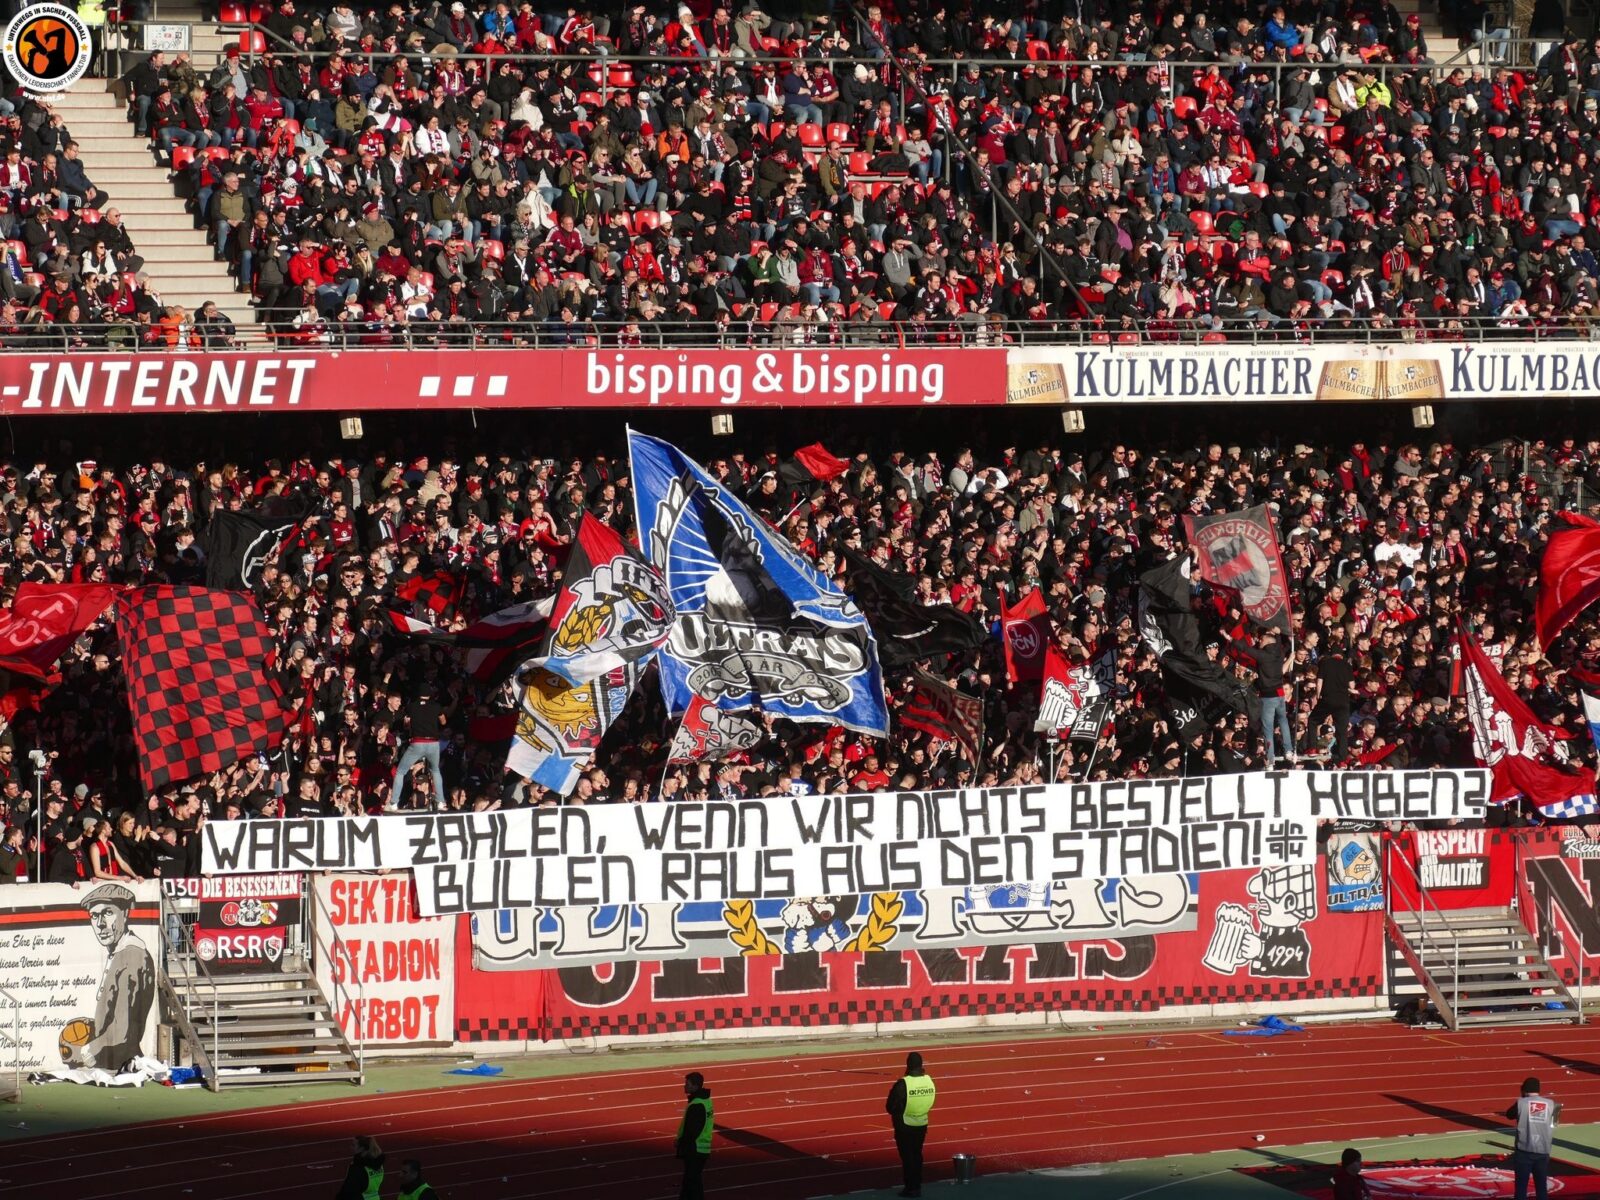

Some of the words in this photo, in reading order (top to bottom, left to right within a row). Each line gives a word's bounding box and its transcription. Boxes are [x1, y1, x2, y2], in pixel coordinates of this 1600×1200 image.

[586, 353, 742, 404] bisping
[751, 353, 784, 393] &
[793, 353, 944, 404] bisping
[1074, 351, 1313, 397] KULMBACHER
[1007, 379, 1063, 402] KULMBACHER
[1323, 375, 1377, 398] KULMBACHER
[1385, 375, 1440, 398] KULMBACHER
[668, 613, 867, 671] ULTRAS
[759, 658, 784, 673] ÅR
[205, 817, 383, 870] WARUM
[405, 807, 607, 865] ZAHLEN,
[634, 801, 769, 851] WENN
[792, 795, 876, 844] WIR
[896, 785, 1047, 842] NICHTS
[1070, 771, 1292, 832] BESTELLT
[1306, 769, 1488, 818] HABEN?
[1416, 829, 1487, 856] RESPEKT
[432, 852, 636, 914] BULLEN
[661, 848, 795, 901] RAUS
[820, 840, 923, 895] AUS
[939, 834, 1034, 887] DEN
[1052, 819, 1262, 881] STADIEN!
[1420, 858, 1484, 888] RIVALITÄT
[163, 878, 200, 897] 030
[201, 877, 223, 898] DIE
[224, 873, 299, 898] BESESSENEN
[1327, 883, 1383, 905] ULTRAS
[330, 878, 443, 927] SEKTI
[12, 934, 30, 948] Ehre
[32, 935, 45, 950] für
[46, 934, 65, 945] diese
[217, 935, 263, 959] RSR
[20, 956, 44, 968] Verein
[45, 955, 61, 966] und
[330, 938, 440, 984] STADION
[1267, 945, 1304, 967] 1994
[20, 976, 58, 990] Nürnbergs
[60, 979, 70, 990] zu
[71, 974, 96, 989] spielen
[24, 1000, 48, 1008] immer
[49, 995, 78, 1008] bewahrt
[335, 995, 440, 1040] VERBOT
[916, 1088, 934, 1096] POWER
